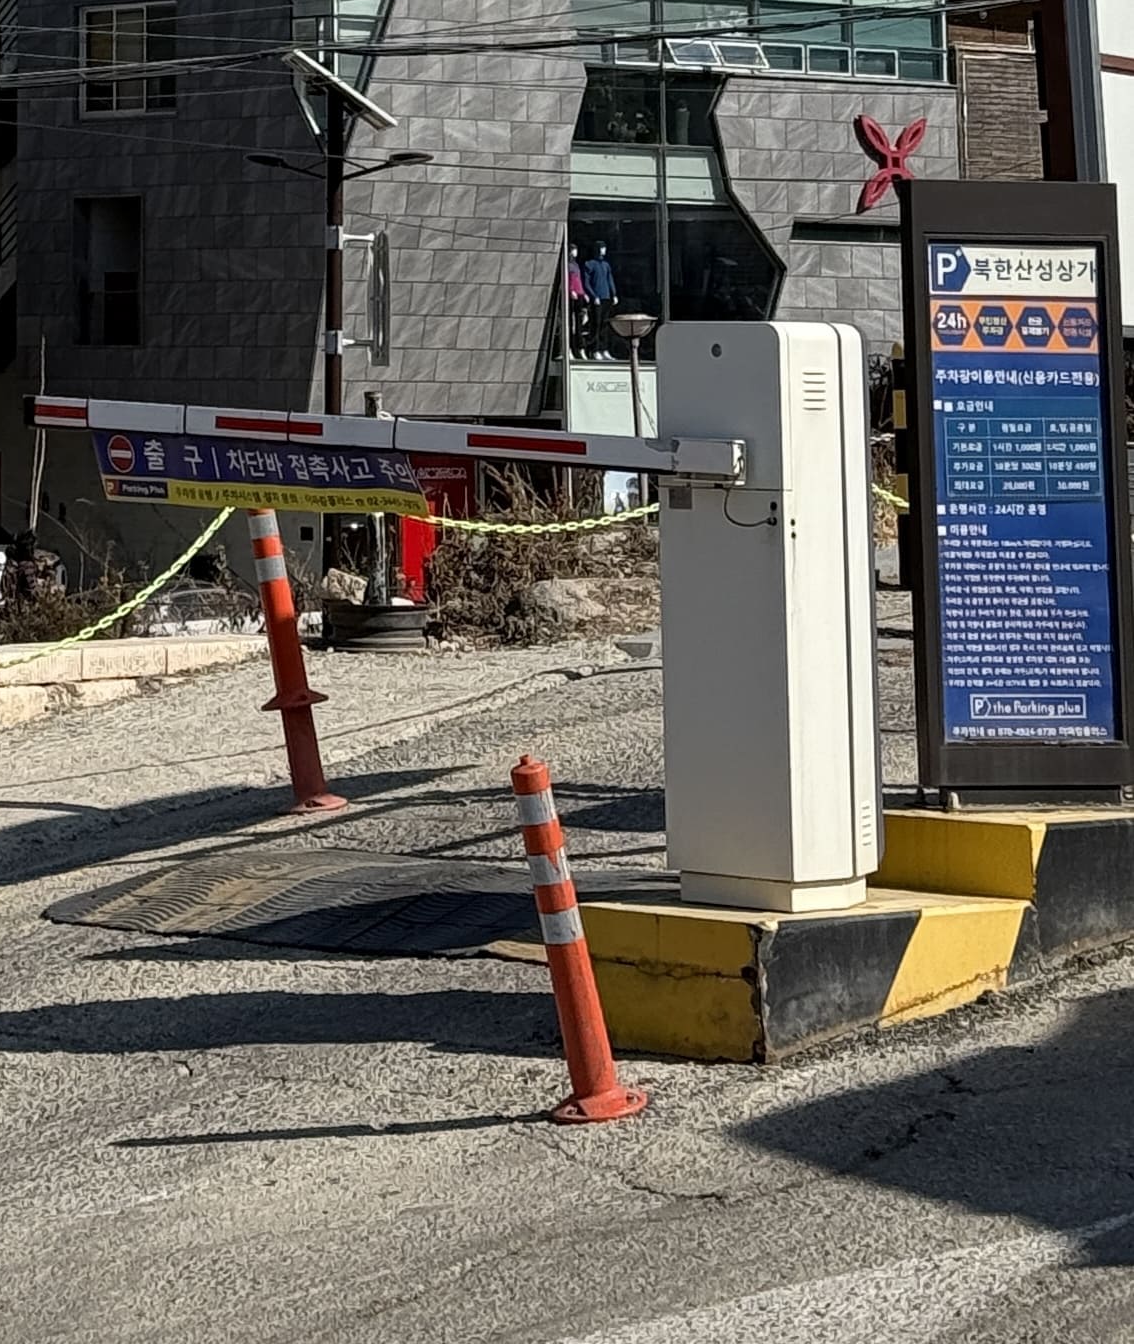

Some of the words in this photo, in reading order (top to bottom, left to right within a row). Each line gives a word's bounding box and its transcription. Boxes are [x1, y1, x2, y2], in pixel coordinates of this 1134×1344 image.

[973, 257, 1098, 284] 북한산성상가
[936, 312, 967, 329] 24h
[143, 440, 165, 472] 출
[183, 445, 204, 475] 구
[226, 449, 283, 480] 차단바
[287, 453, 375, 482] 접촉사고
[380, 458, 415, 485] 주의
[993, 701, 1011, 713] the
[1014, 701, 1055, 717] Parking
